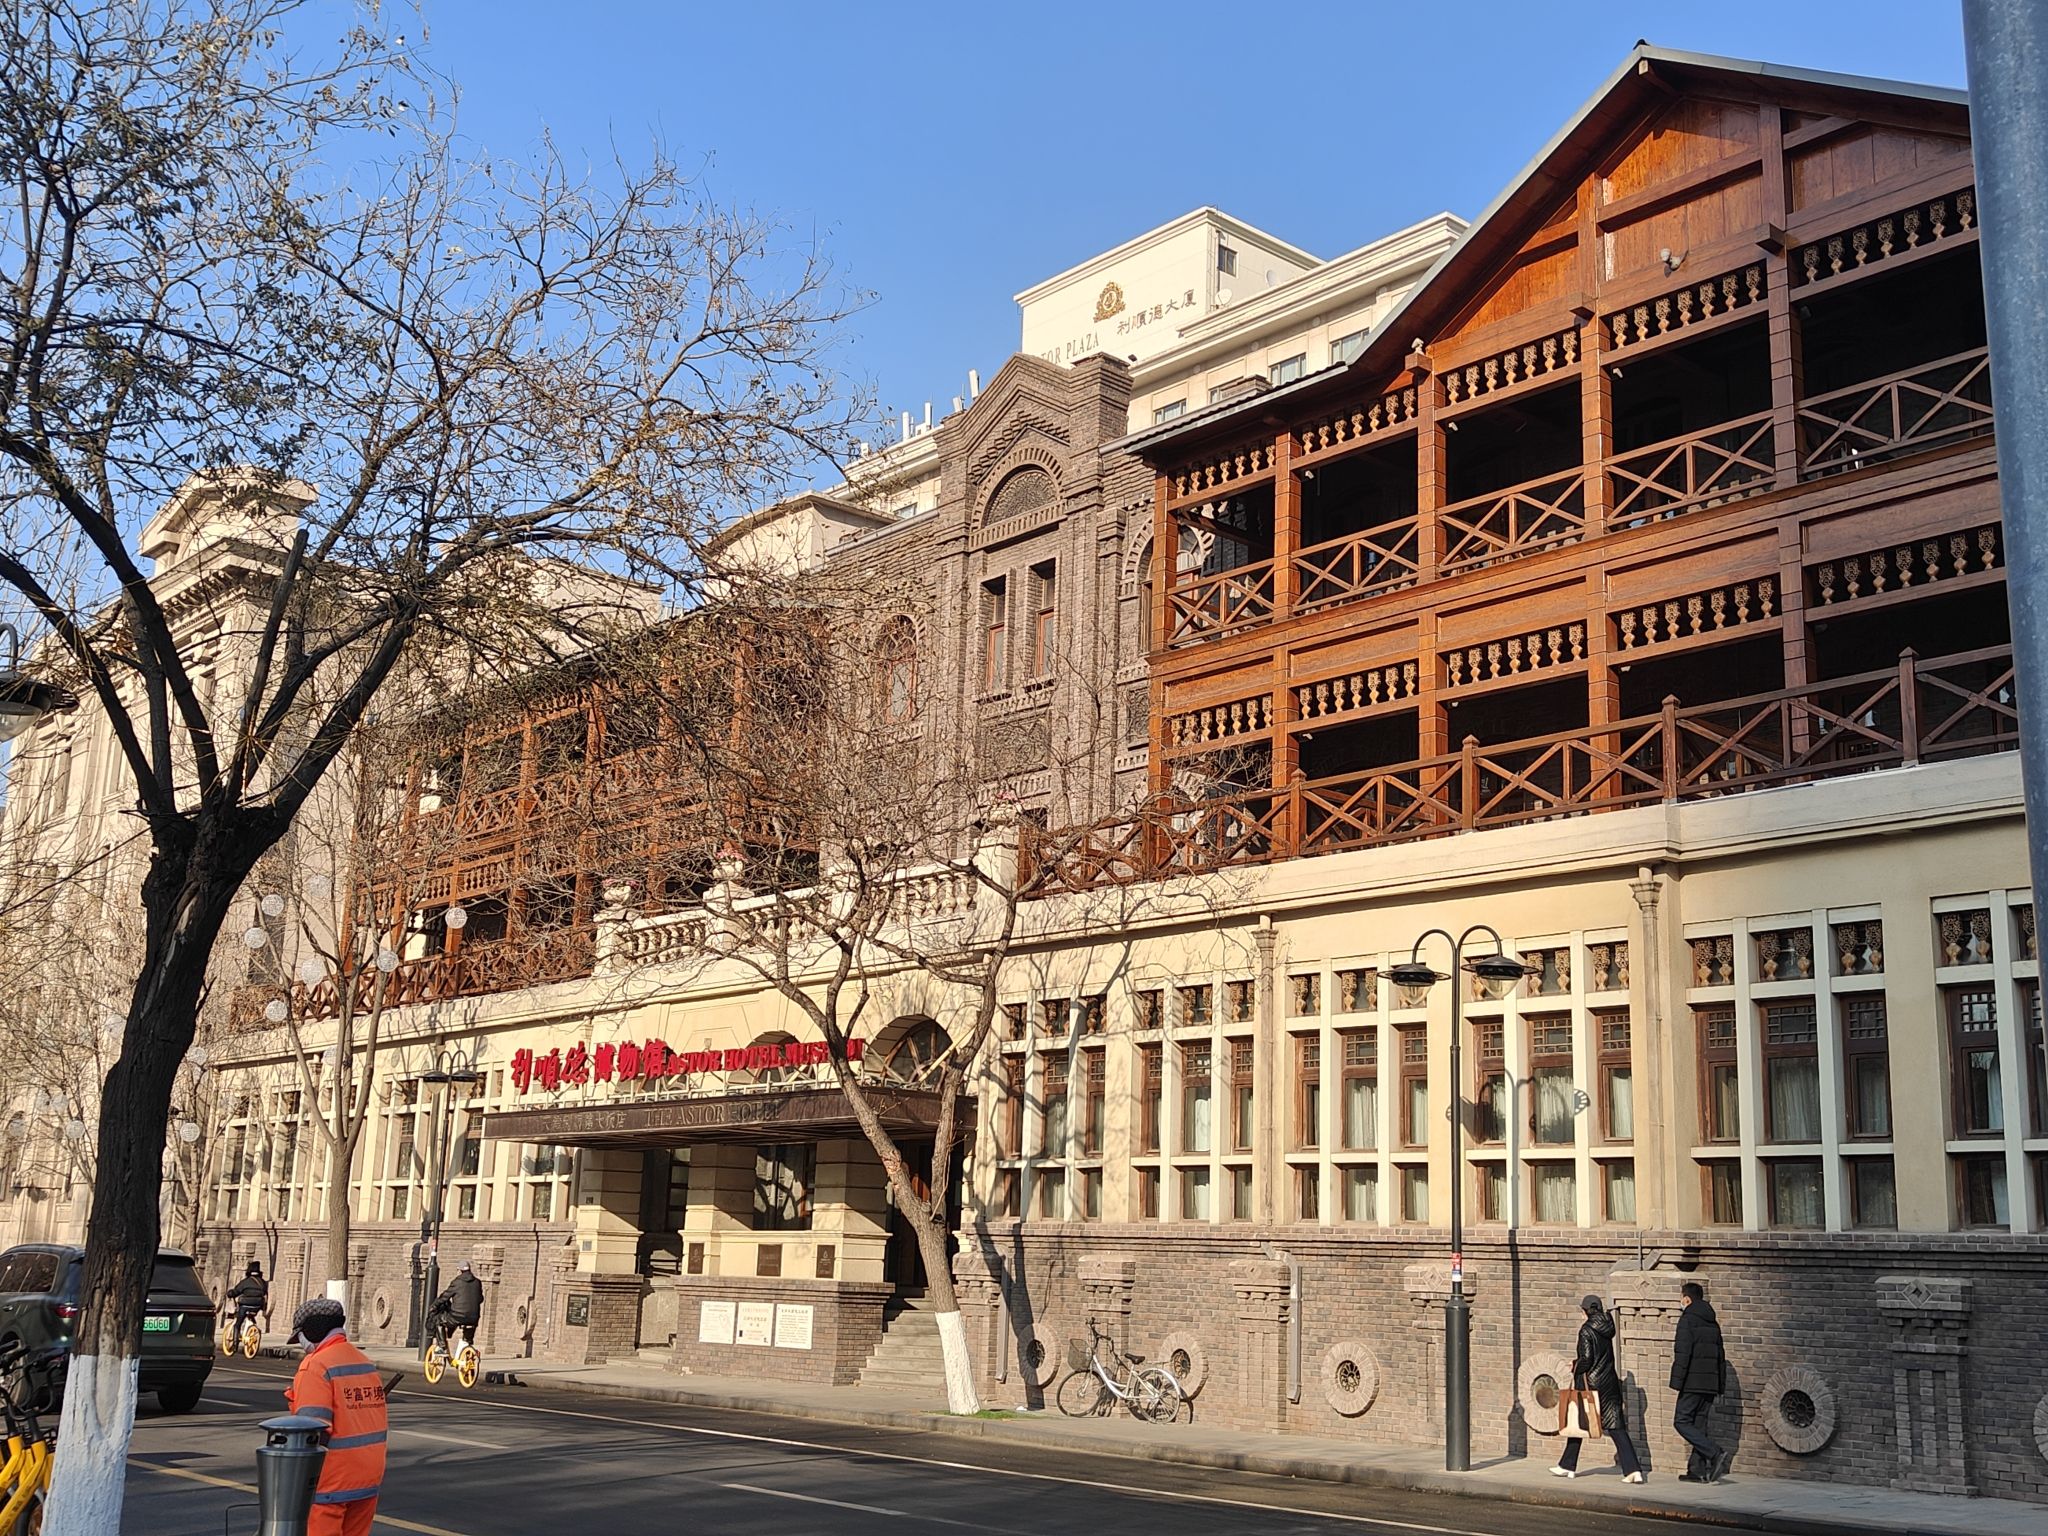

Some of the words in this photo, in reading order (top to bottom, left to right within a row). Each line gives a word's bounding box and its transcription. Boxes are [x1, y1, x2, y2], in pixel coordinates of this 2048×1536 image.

[1066, 330, 1099, 359] PLAZA
[667, 1050, 722, 1076] ASTOR
[724, 1044, 782, 1071] HOTEL
[784, 1037, 866, 1066] MUSEM
[643, 1107, 673, 1127] THE
[676, 1103, 725, 1125] ASTOR
[728, 1098, 782, 1122] HOTEL
[343, 1386, 384, 1402] 华富环境
